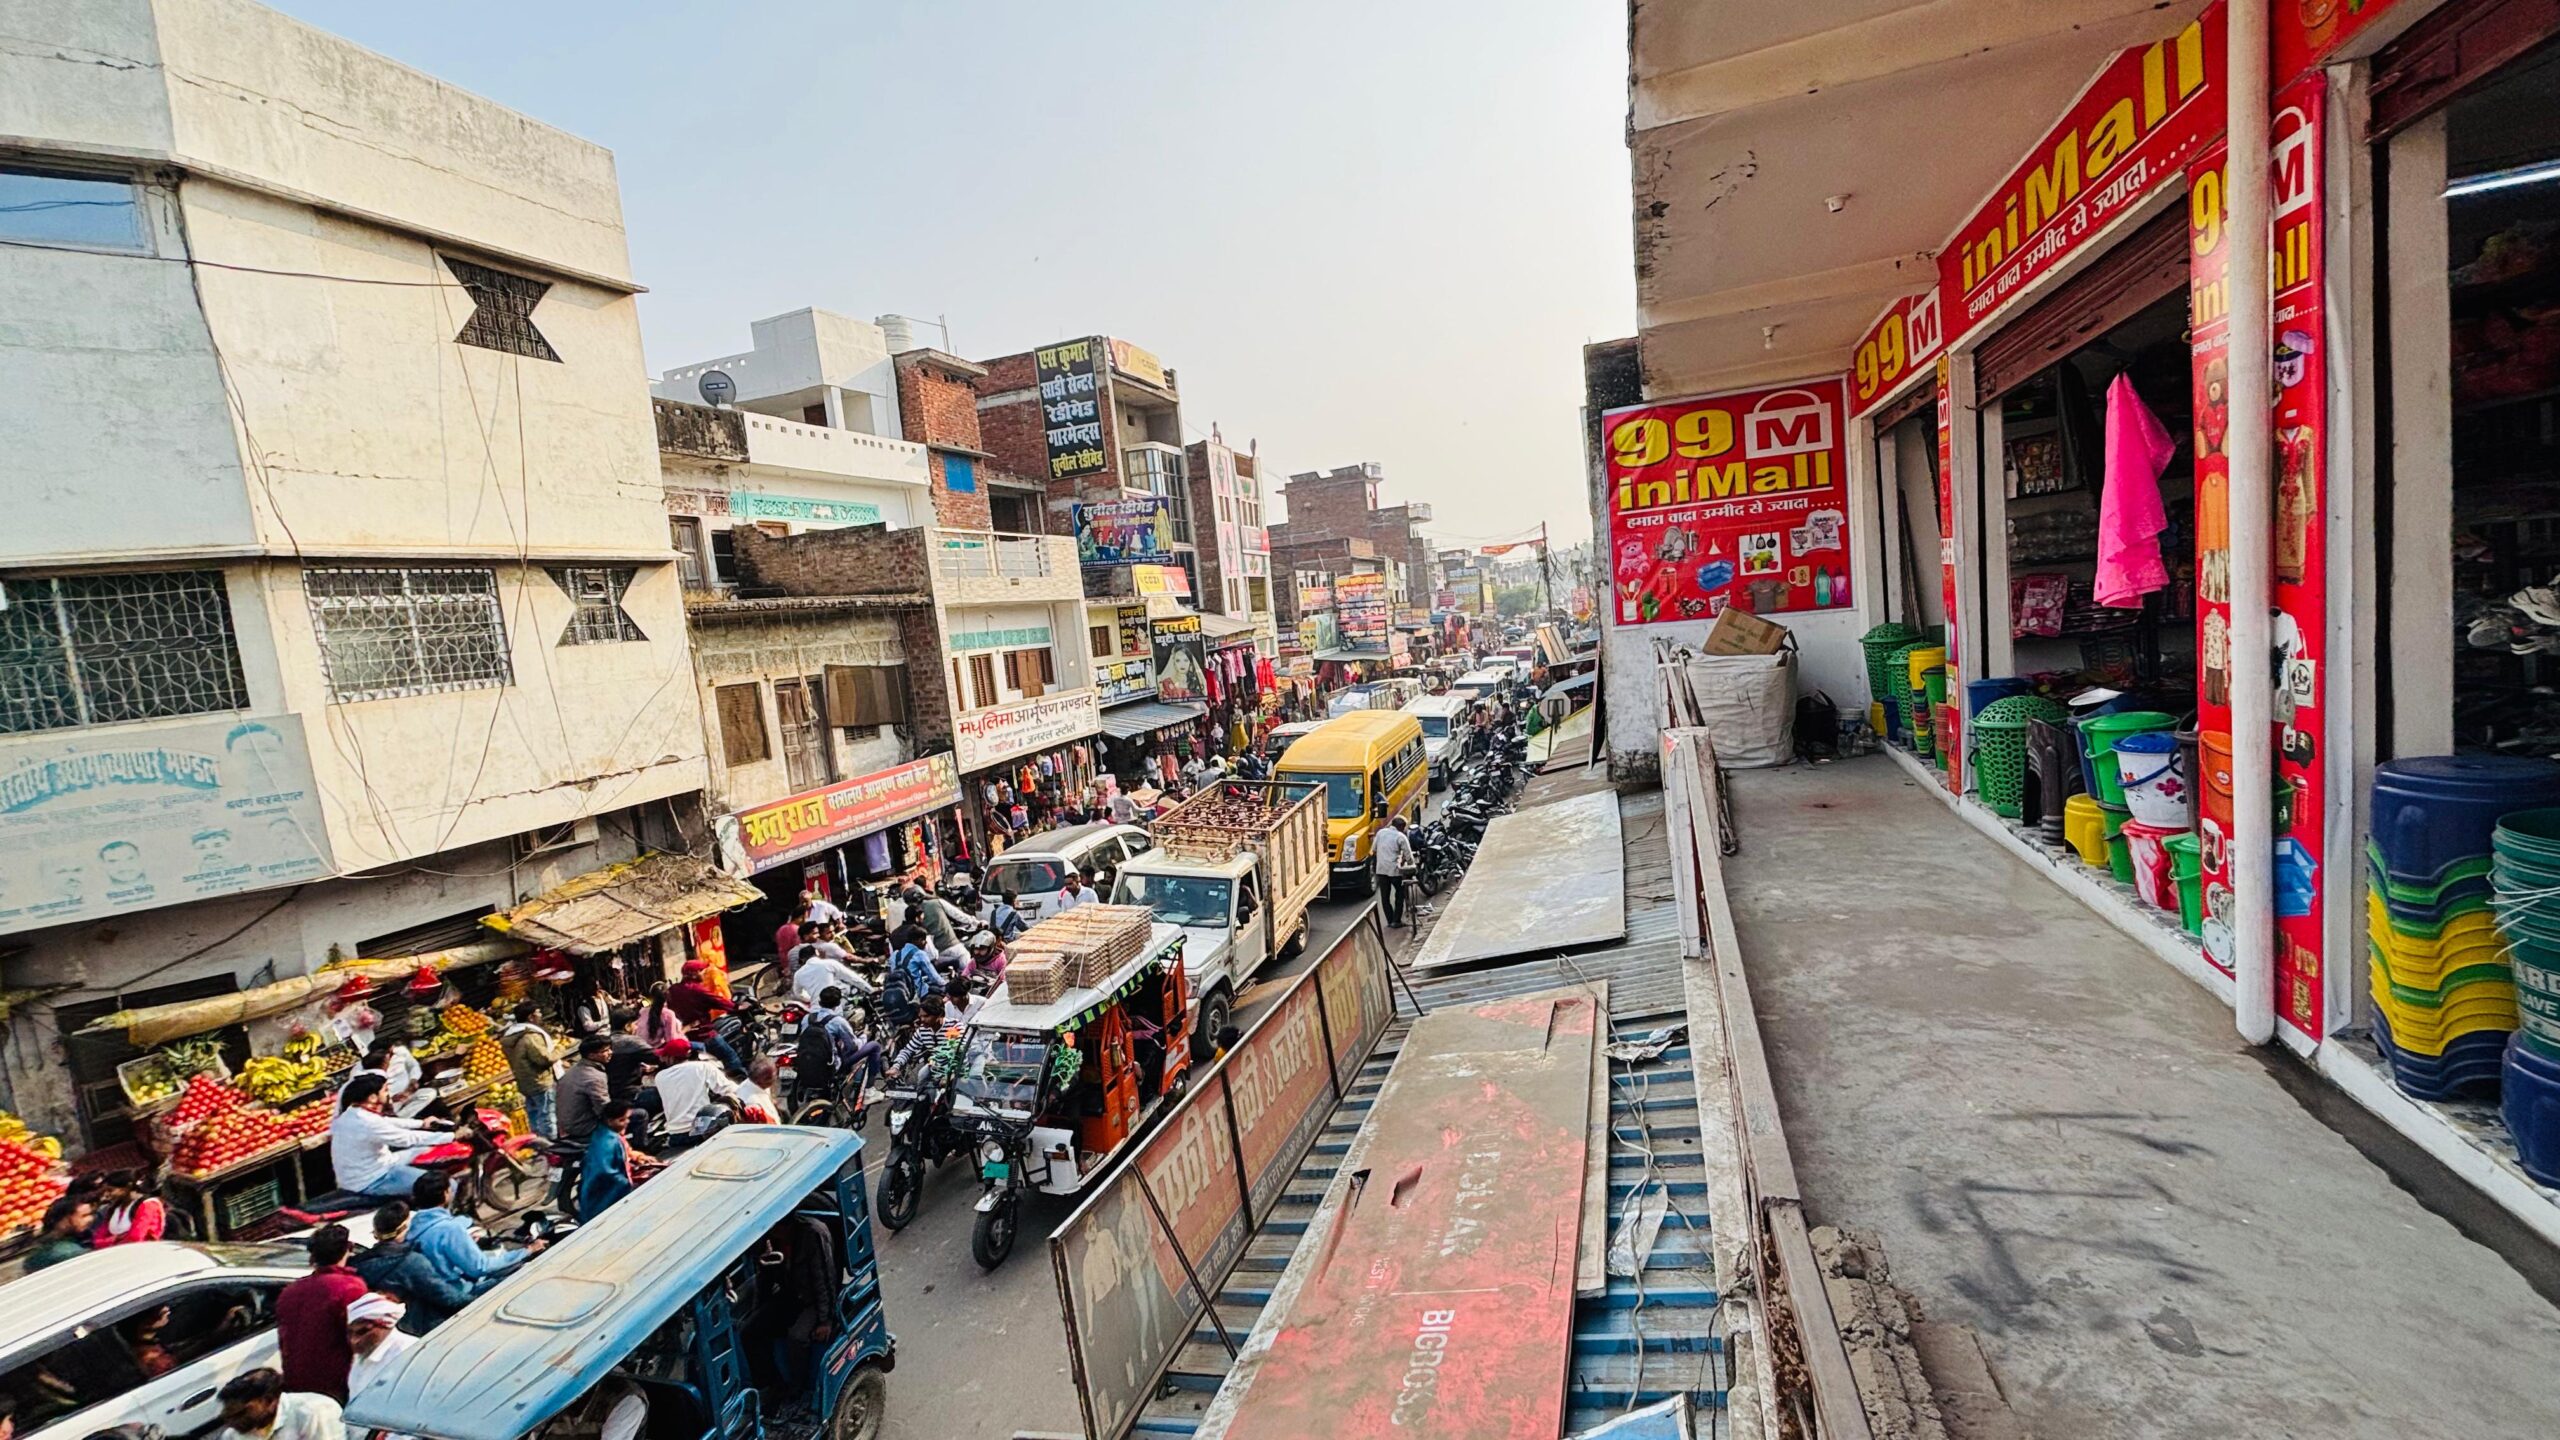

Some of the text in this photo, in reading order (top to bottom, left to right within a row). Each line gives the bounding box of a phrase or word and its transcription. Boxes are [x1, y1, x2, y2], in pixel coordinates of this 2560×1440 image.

[1962, 19, 2204, 293] iniMall
[2193, 160, 2229, 256] 9
[1968, 282, 1996, 319] हमारा
[1997, 266, 2020, 298] वादा
[2023, 226, 2067, 274] उम्मीद
[2071, 203, 2088, 236] से
[1038, 341, 1089, 371] एस कुमार
[1856, 312, 1905, 400] 99
[1040, 372, 1095, 400] साड़ी सेन्टर
[1044, 399, 1095, 423] रेडीमेड
[1613, 409, 1735, 468] 99
[1051, 448, 1103, 477] सुनील रेडीमेड
[1618, 450, 1831, 510] iniMall
[1082, 499, 1155, 521] सुनील रेडीमेड
[1627, 515, 1664, 529] हमारा
[1668, 511, 1697, 524] वादा
[1701, 503, 1745, 521] उम्मीद
[1750, 500, 1762, 514] से
[1154, 617, 1200, 634] लवली
[1154, 633, 1175, 647] ब्यूटी
[959, 712, 1014, 738] मधुलिमा
[1060, 695, 1092, 712] भण्डार
[1026, 729, 1053, 745] जनरल
[742, 795, 829, 846] ऋतुराज
